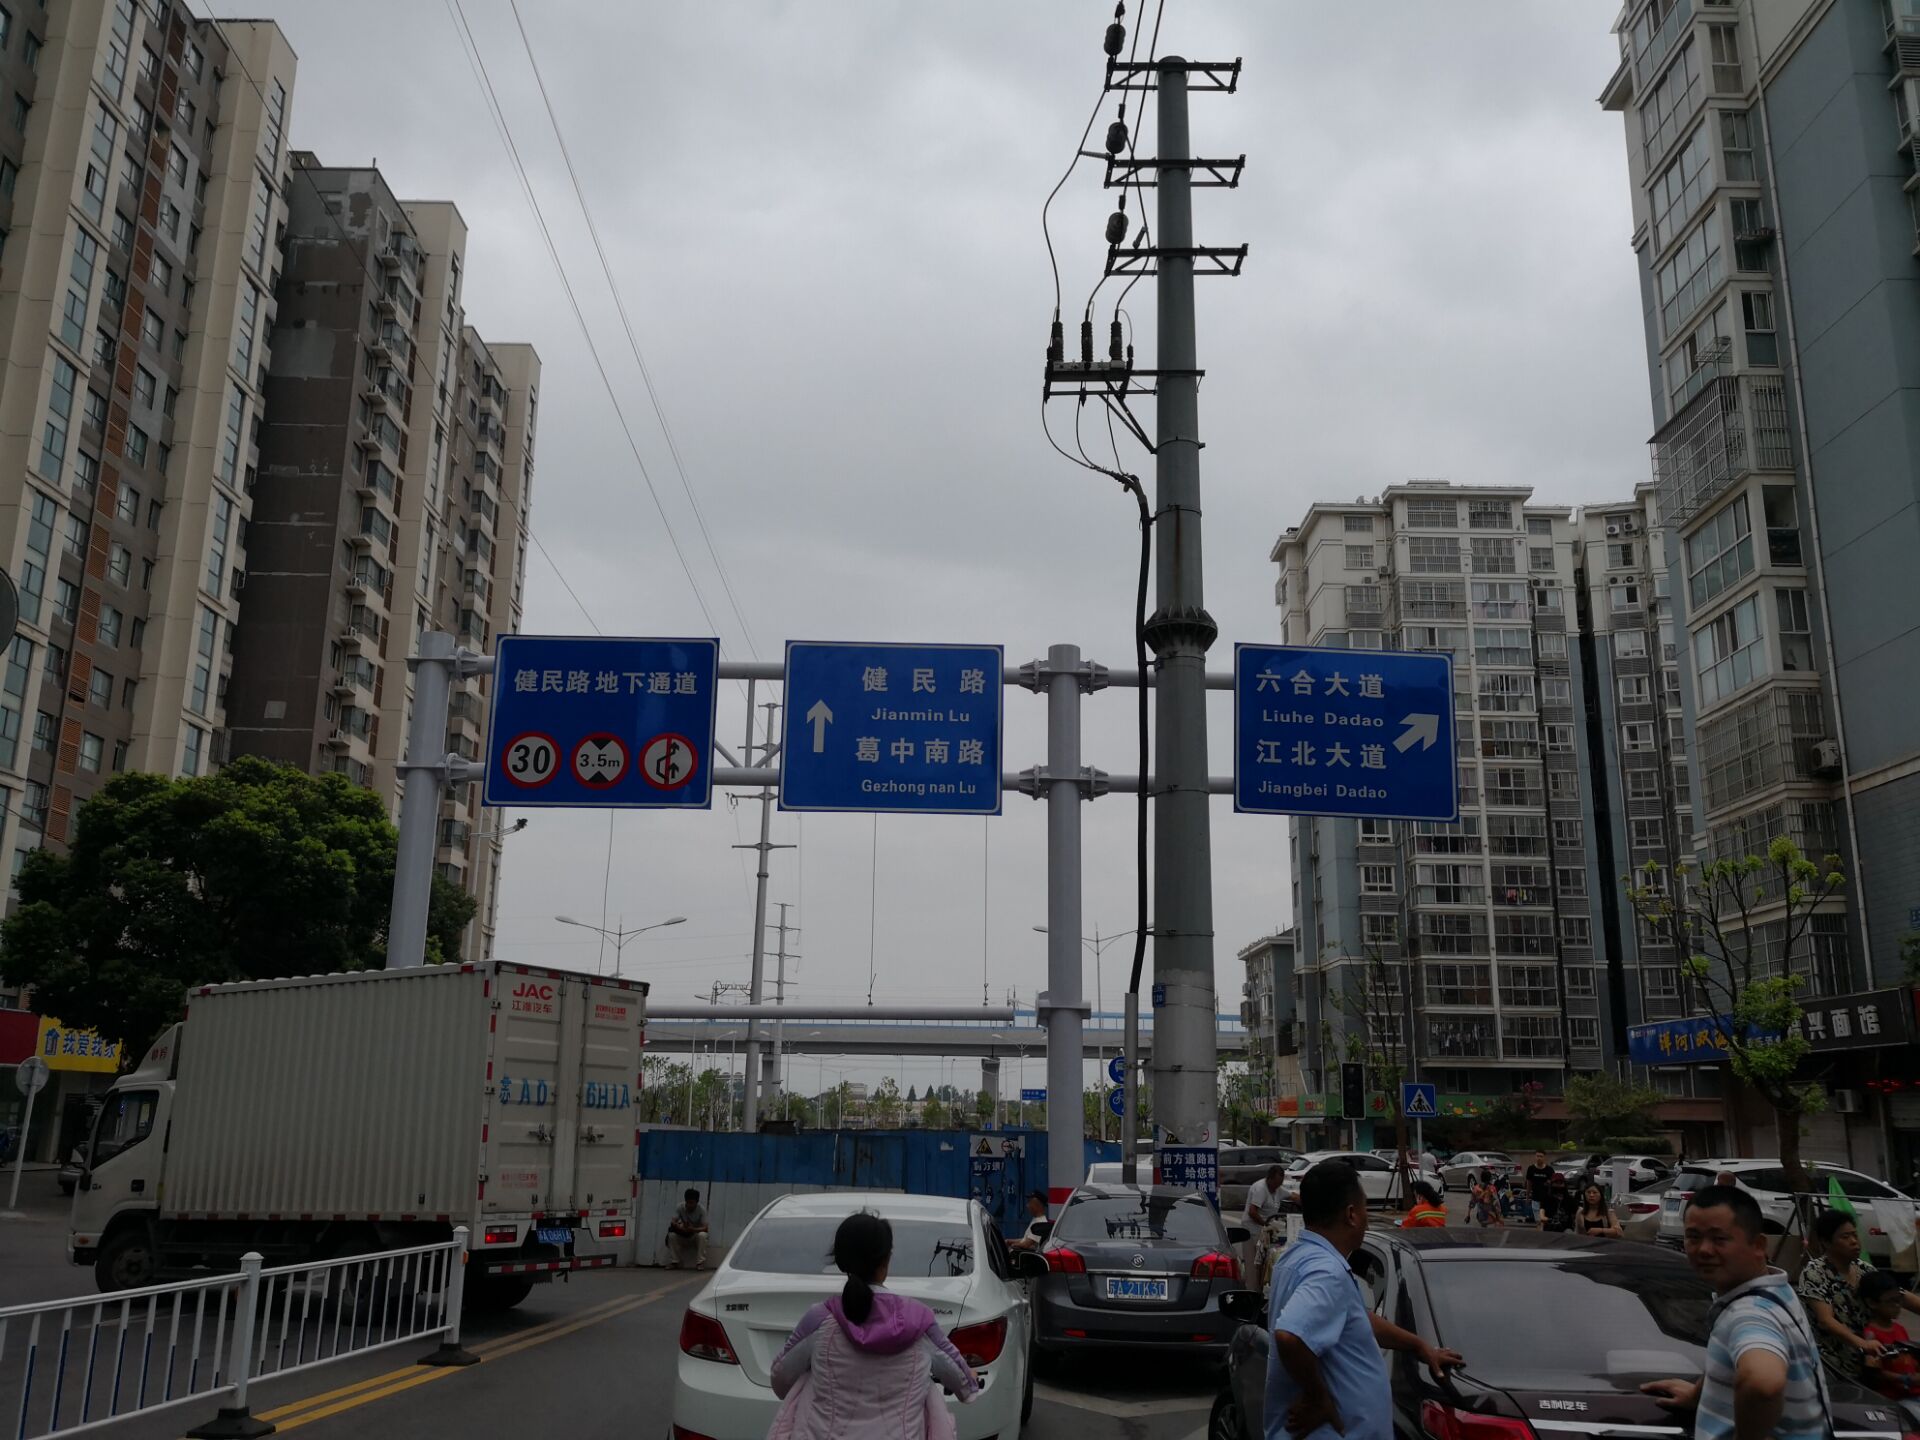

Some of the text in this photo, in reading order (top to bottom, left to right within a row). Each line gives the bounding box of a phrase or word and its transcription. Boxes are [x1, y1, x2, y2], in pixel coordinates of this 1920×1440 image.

[513, 668, 698, 695] 健民路地下通道
[861, 665, 986, 694] 健民路
[1255, 668, 1385, 698] 六合大道
[871, 707, 970, 722] Jianmin Lu
[1263, 709, 1384, 727] Liuhe Dadao
[511, 744, 551, 773] 30
[855, 736, 985, 765] 葛中南路
[1256, 739, 1387, 769] 江北大道
[578, 752, 621, 769] 3.5m
[861, 779, 926, 796] Gezhong
[959, 783, 976, 795] Lu
[1258, 780, 1387, 799] Jiangbei Dadao
[513, 982, 553, 1000] JAC
[1538, 1399, 1589, 1411] 吉利汽车
